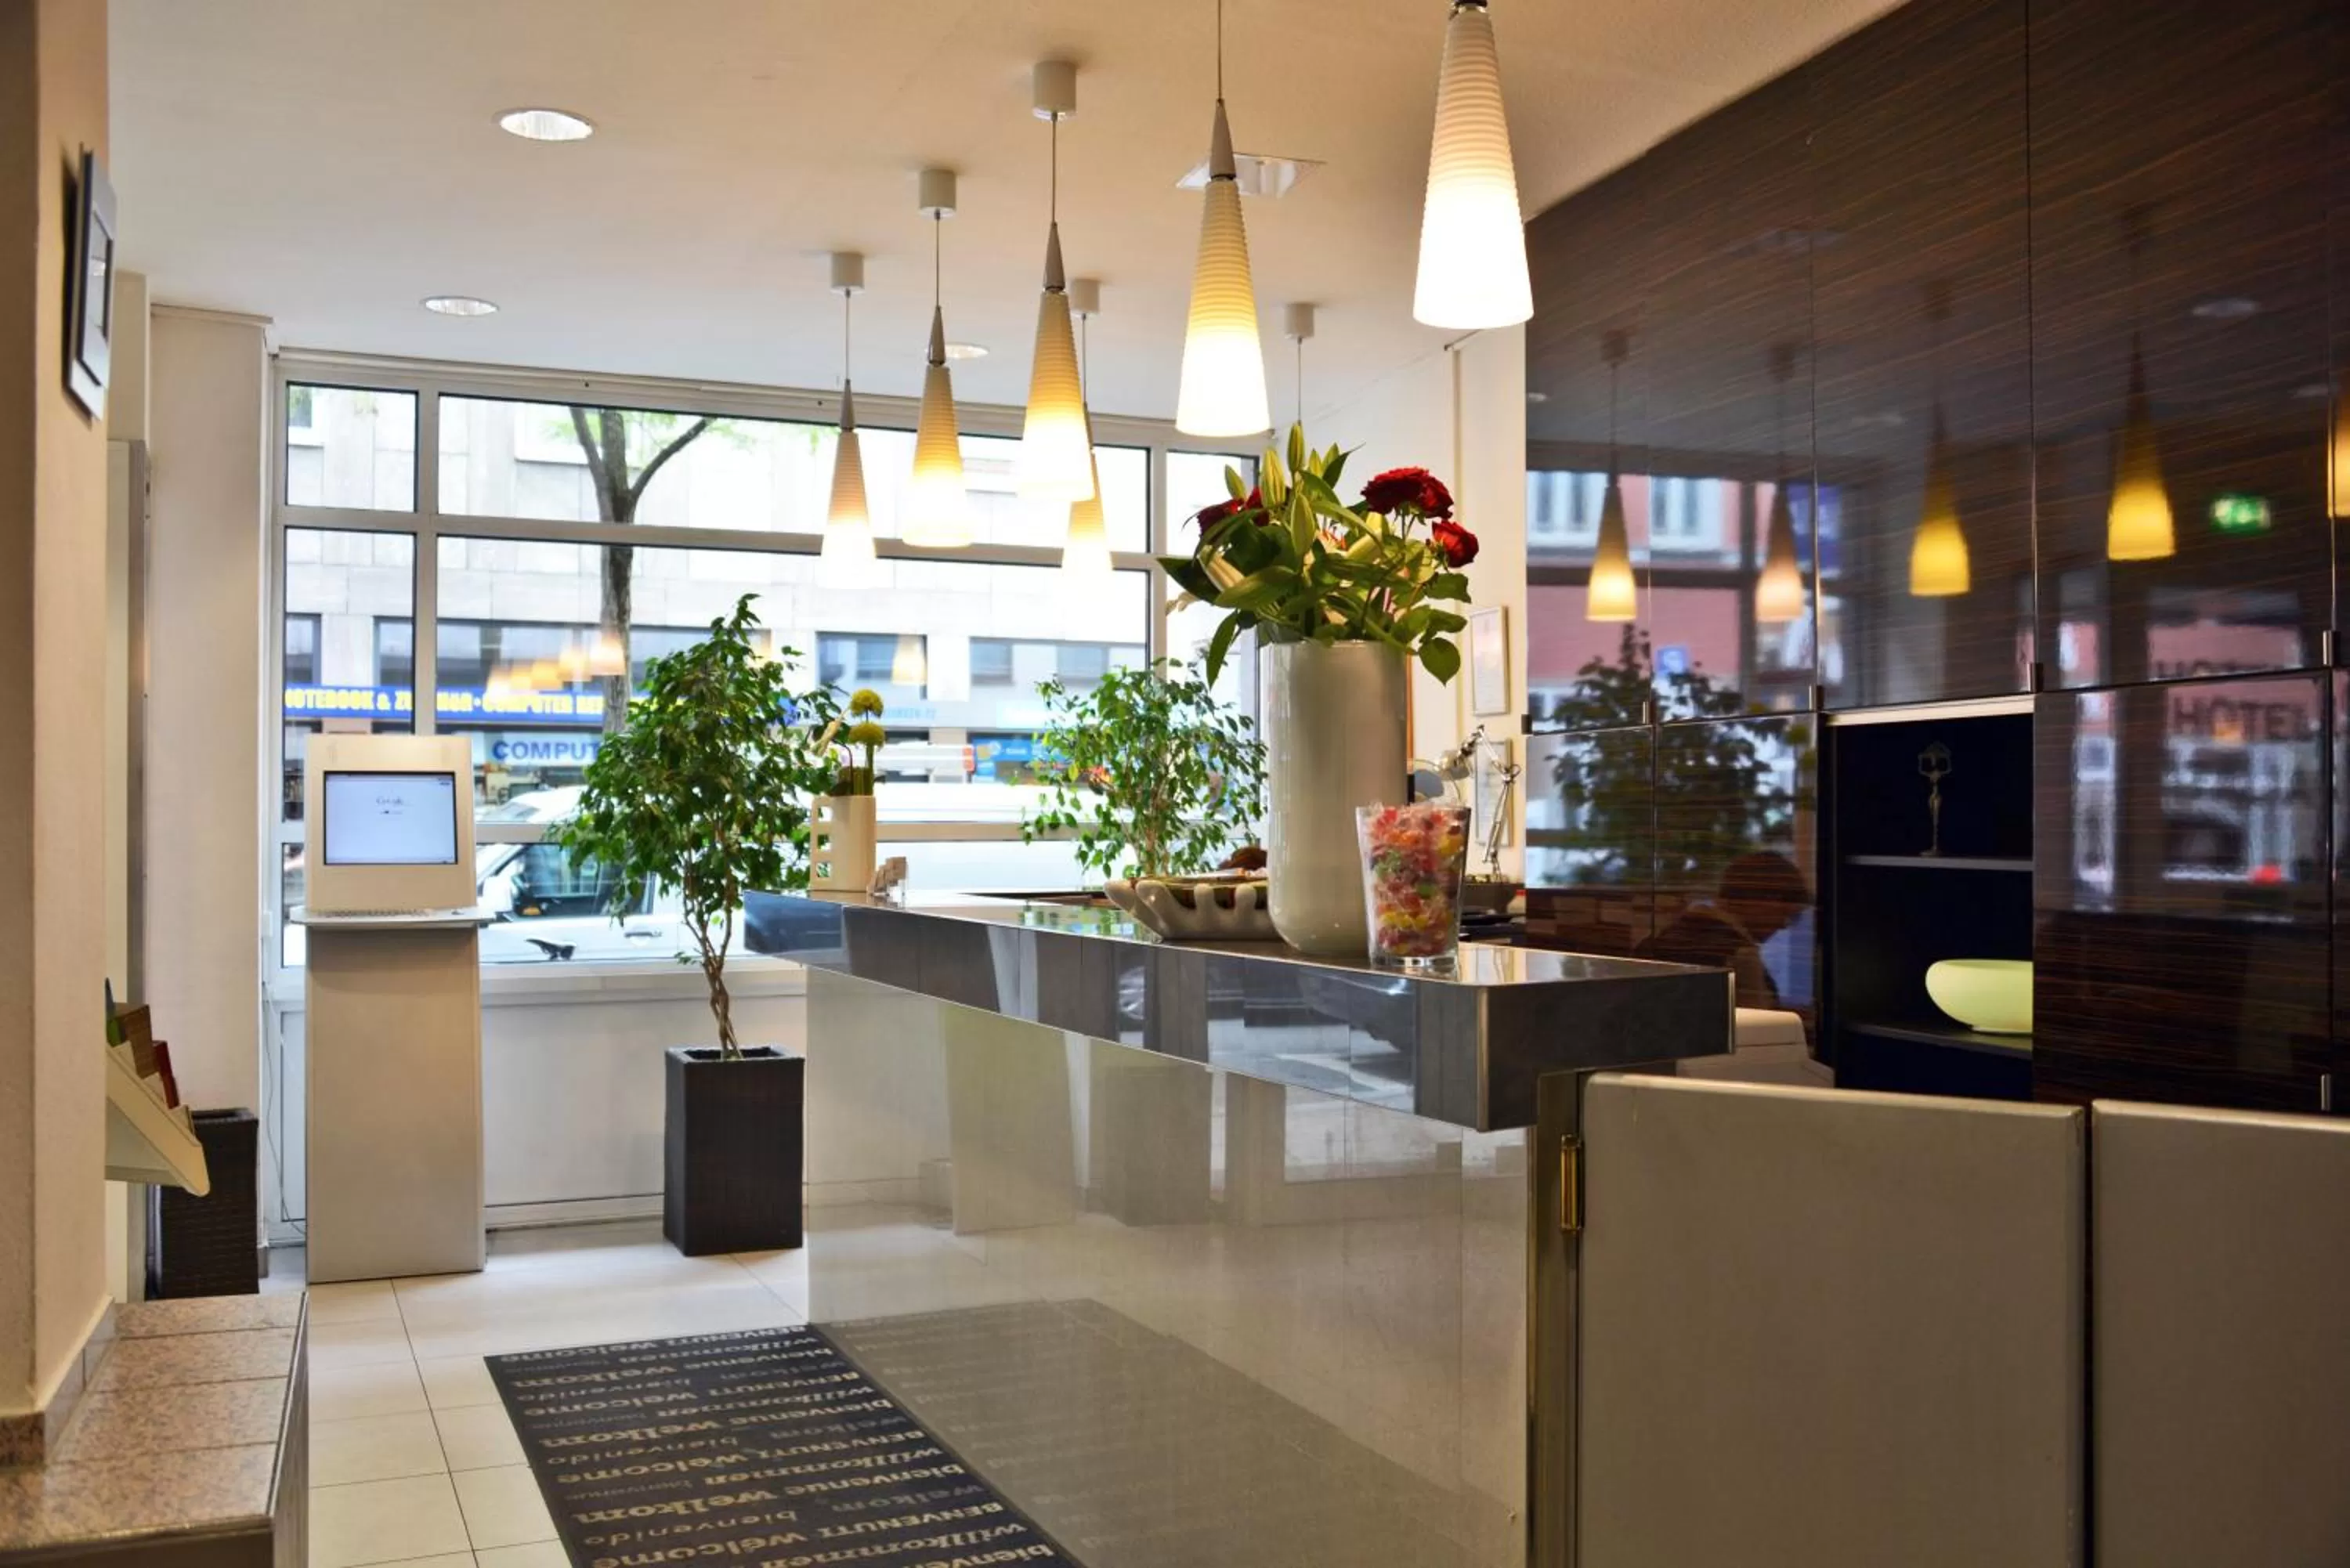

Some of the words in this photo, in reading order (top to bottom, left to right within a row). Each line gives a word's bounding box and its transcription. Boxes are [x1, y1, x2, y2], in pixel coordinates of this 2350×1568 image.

[492, 739, 602, 761] COMPUT
[501, 1342, 659, 1362] welcome
[618, 1337, 819, 1363] willkommen
[512, 1365, 678, 1388] welkom
[709, 1371, 860, 1396] BENVENUTI
[523, 1392, 699, 1416] welcome
[656, 1386, 875, 1418] willkommen
[728, 1399, 894, 1425] bienvenue
[539, 1420, 722, 1447] welkom
[757, 1430, 926, 1459] BENVENUTI
[547, 1436, 739, 1465] bienvenido
[556, 1453, 749, 1483] welcome
[703, 1447, 943, 1486] willkommen
[784, 1463, 966, 1495] bienvenue
[571, 1490, 778, 1524] welkom
[831, 1484, 985, 1512] welkom
[584, 1510, 797, 1547] bienvenido
[817, 1501, 1004, 1539] BENVENUTI
[591, 1532, 809, 1568] welcome
[759, 1523, 1029, 1568] willkommen
